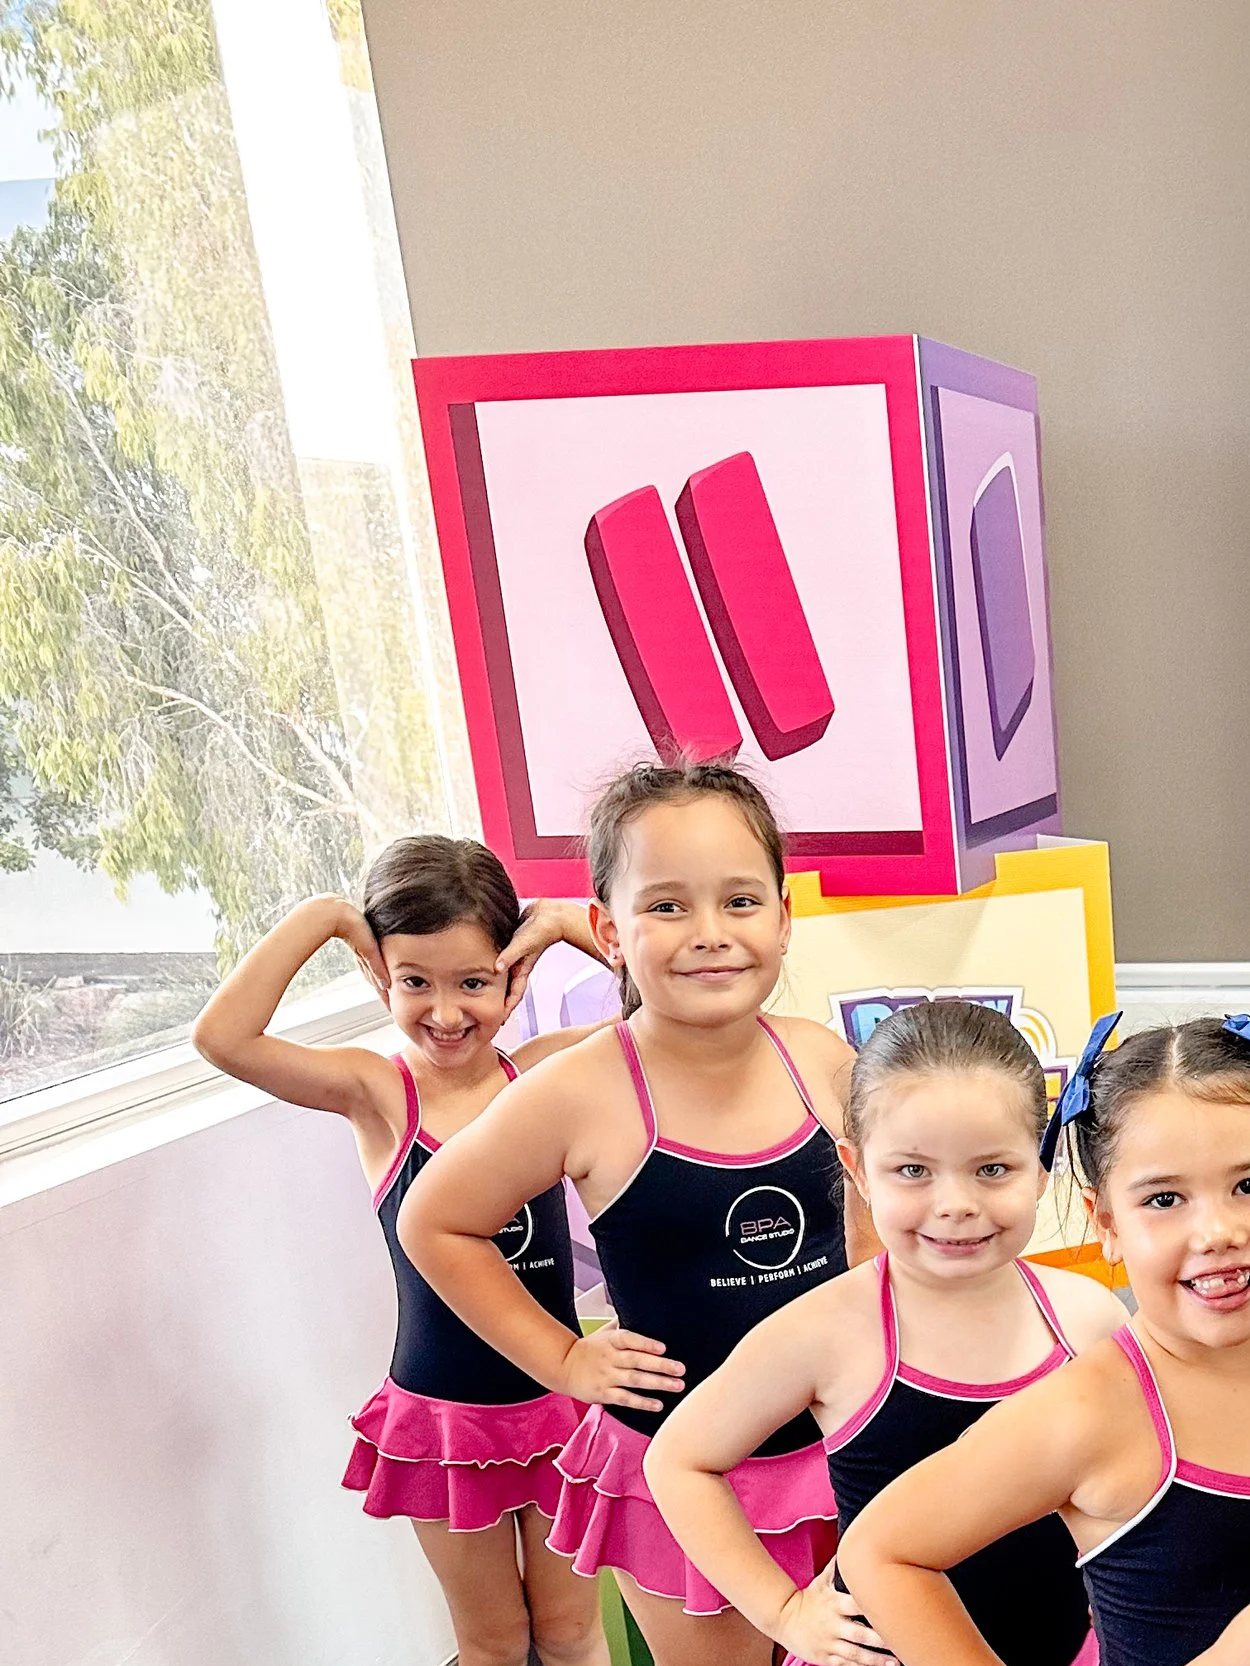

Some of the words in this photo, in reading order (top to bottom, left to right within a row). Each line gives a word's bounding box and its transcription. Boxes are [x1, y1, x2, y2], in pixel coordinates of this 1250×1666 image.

[740, 1216, 791, 1235] BPA
[741, 1234, 767, 1244] DANCE
[768, 1228, 794, 1239] STUDIO
[529, 1257, 555, 1269] ACHIEVE
[710, 1276, 747, 1287] BELIEVE
[758, 1270, 796, 1283] PERFORM
[803, 1256, 828, 1272] ACHIEVE
